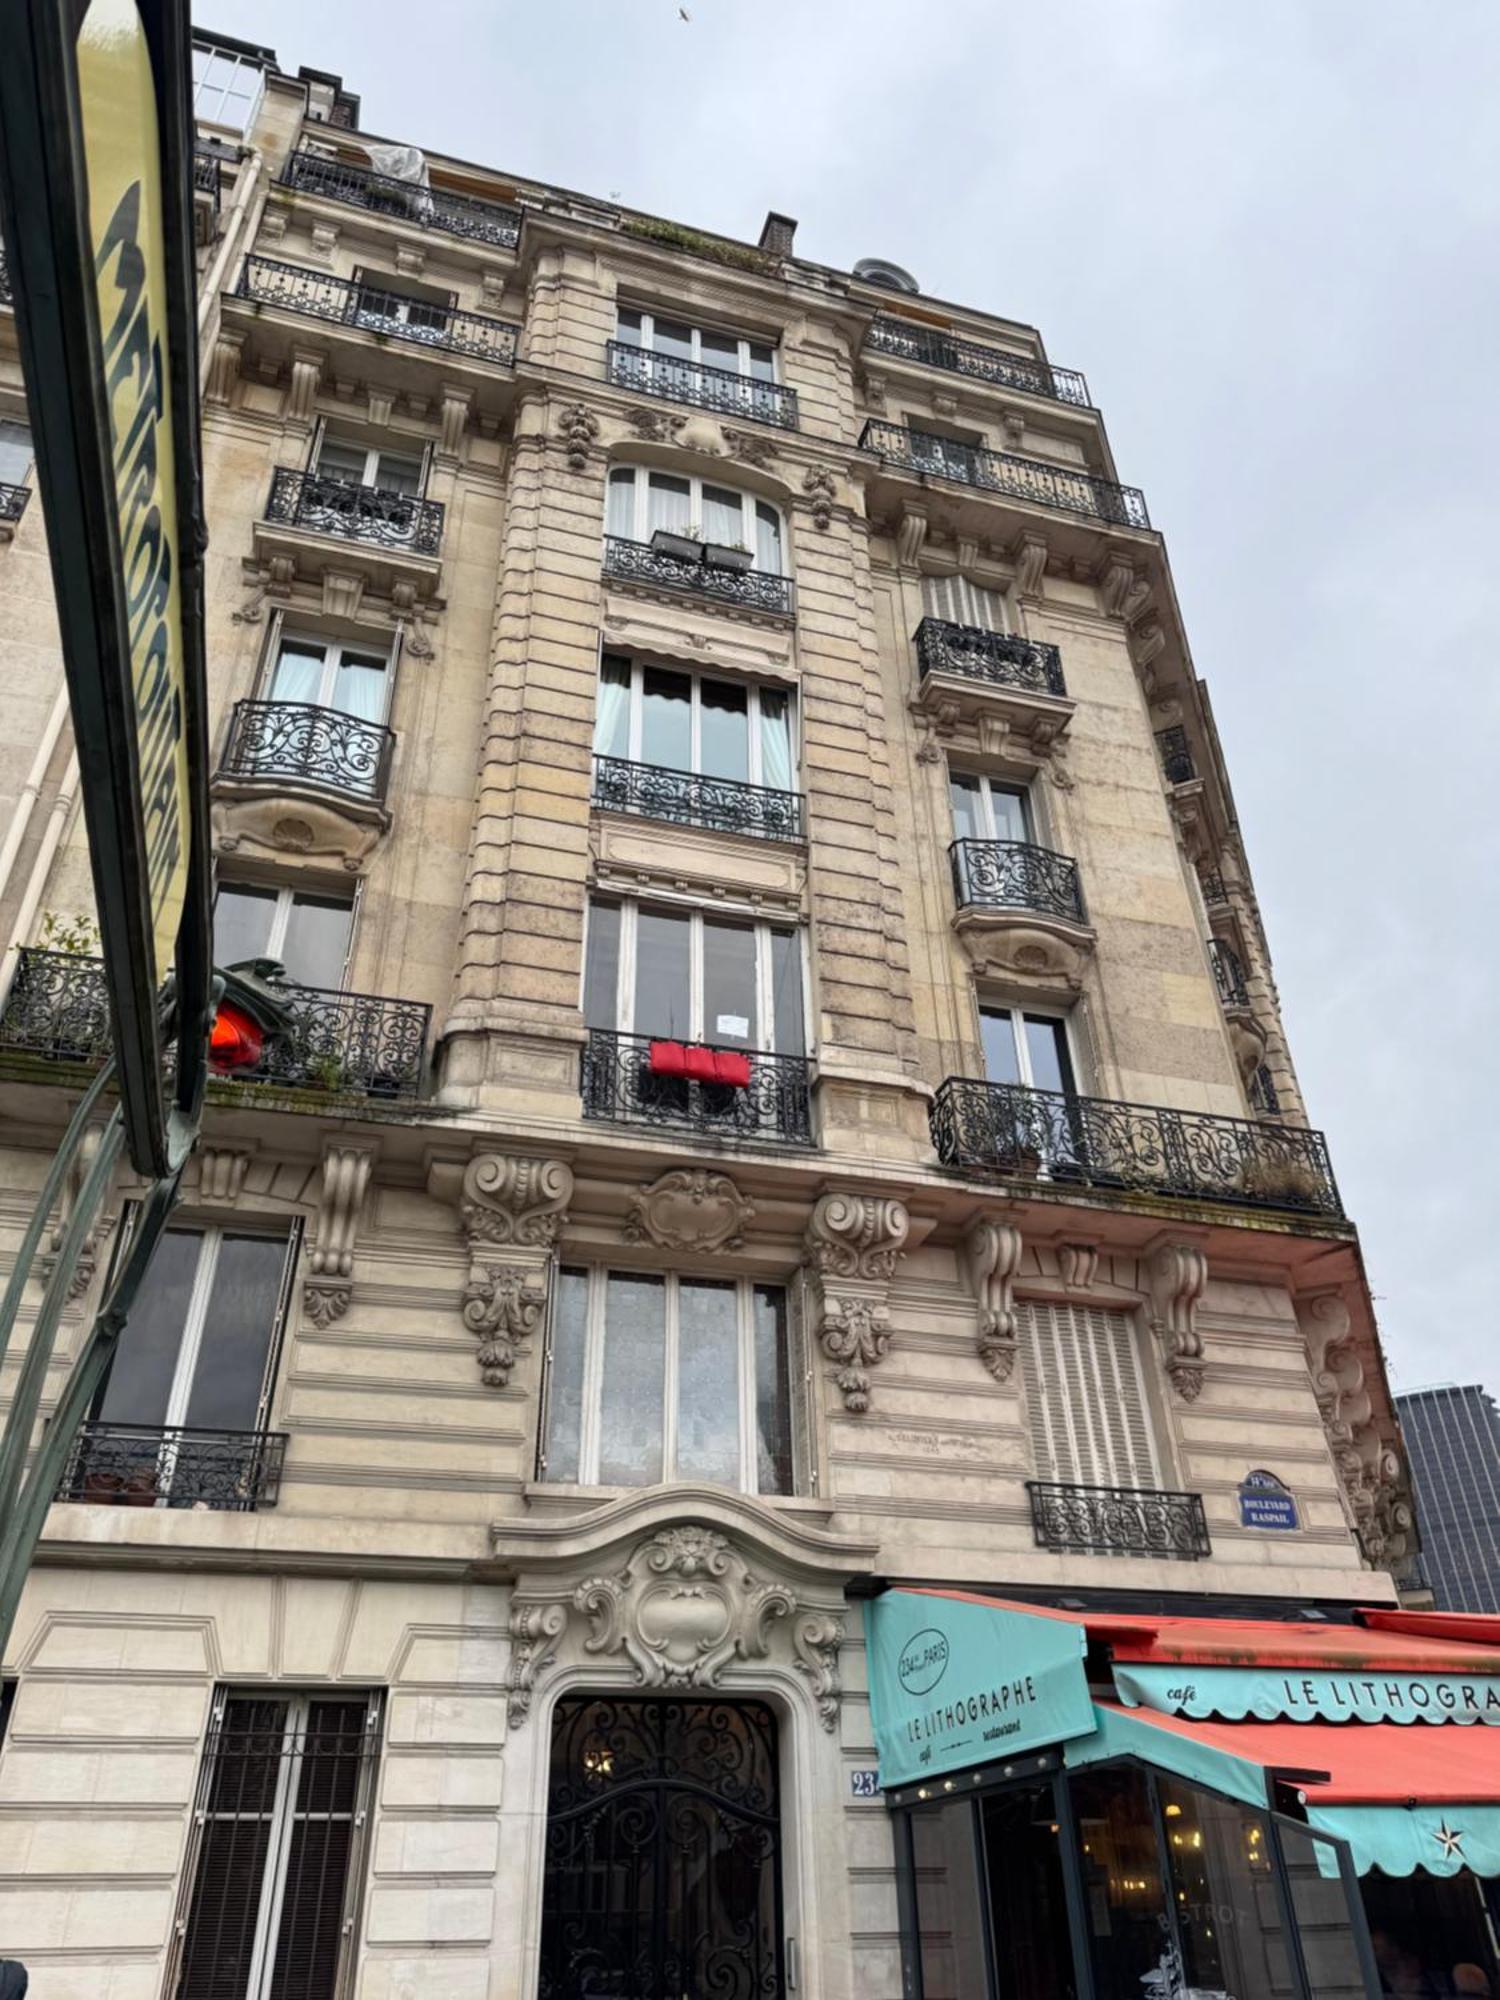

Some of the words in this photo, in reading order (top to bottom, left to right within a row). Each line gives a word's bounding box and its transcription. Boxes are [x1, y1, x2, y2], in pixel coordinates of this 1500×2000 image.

[1244, 1500, 1290, 1511] BOULEVARD
[1251, 1512, 1290, 1524] RASPAIL
[1167, 1684, 1196, 1706] café
[1284, 1680, 1319, 1705] LE
[1331, 1681, 1500, 1710] LITHOGRA
[907, 1718, 921, 1742] LE
[924, 1676, 1036, 1737] LITHOGRAPHE
[1159, 1903, 1249, 1932] BSTROT
